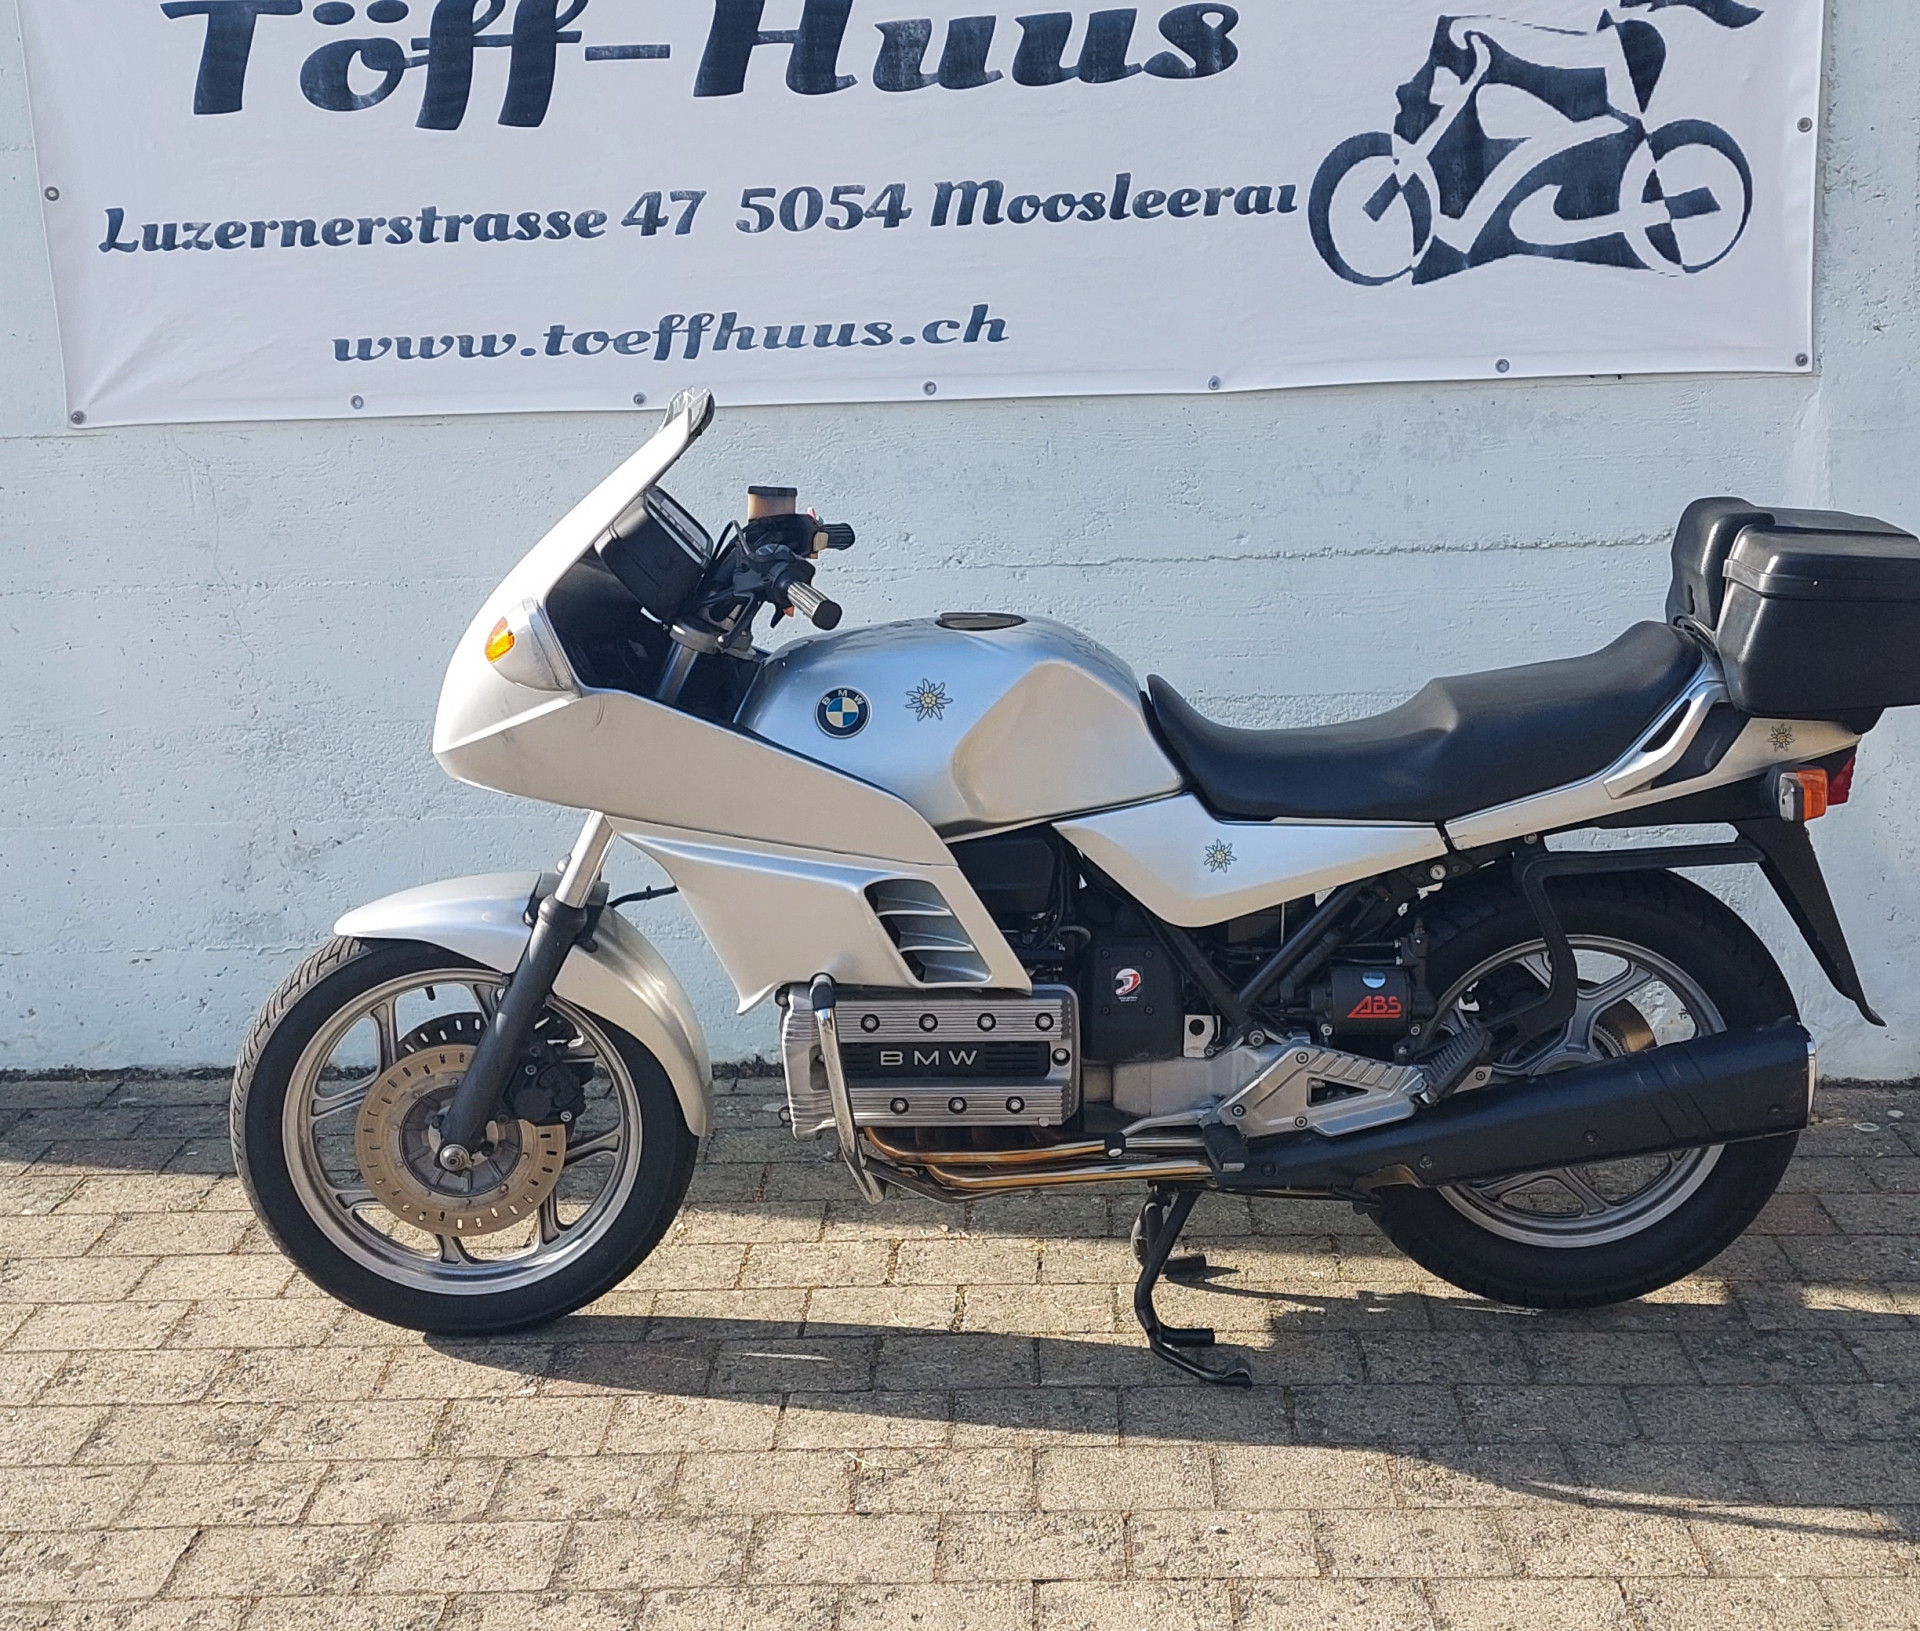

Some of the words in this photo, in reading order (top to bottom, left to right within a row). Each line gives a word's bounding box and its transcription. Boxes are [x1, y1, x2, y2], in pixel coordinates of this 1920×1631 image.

[99, 207, 608, 252] Luzernerstrasse
[621, 190, 707, 236] 47
[735, 184, 912, 234] 5054
[332, 304, 1010, 361] www.toeffhuus.ch
[821, 689, 865, 706] BMW
[1346, 995, 1402, 1019] ABS
[880, 1049, 978, 1066] BMW
